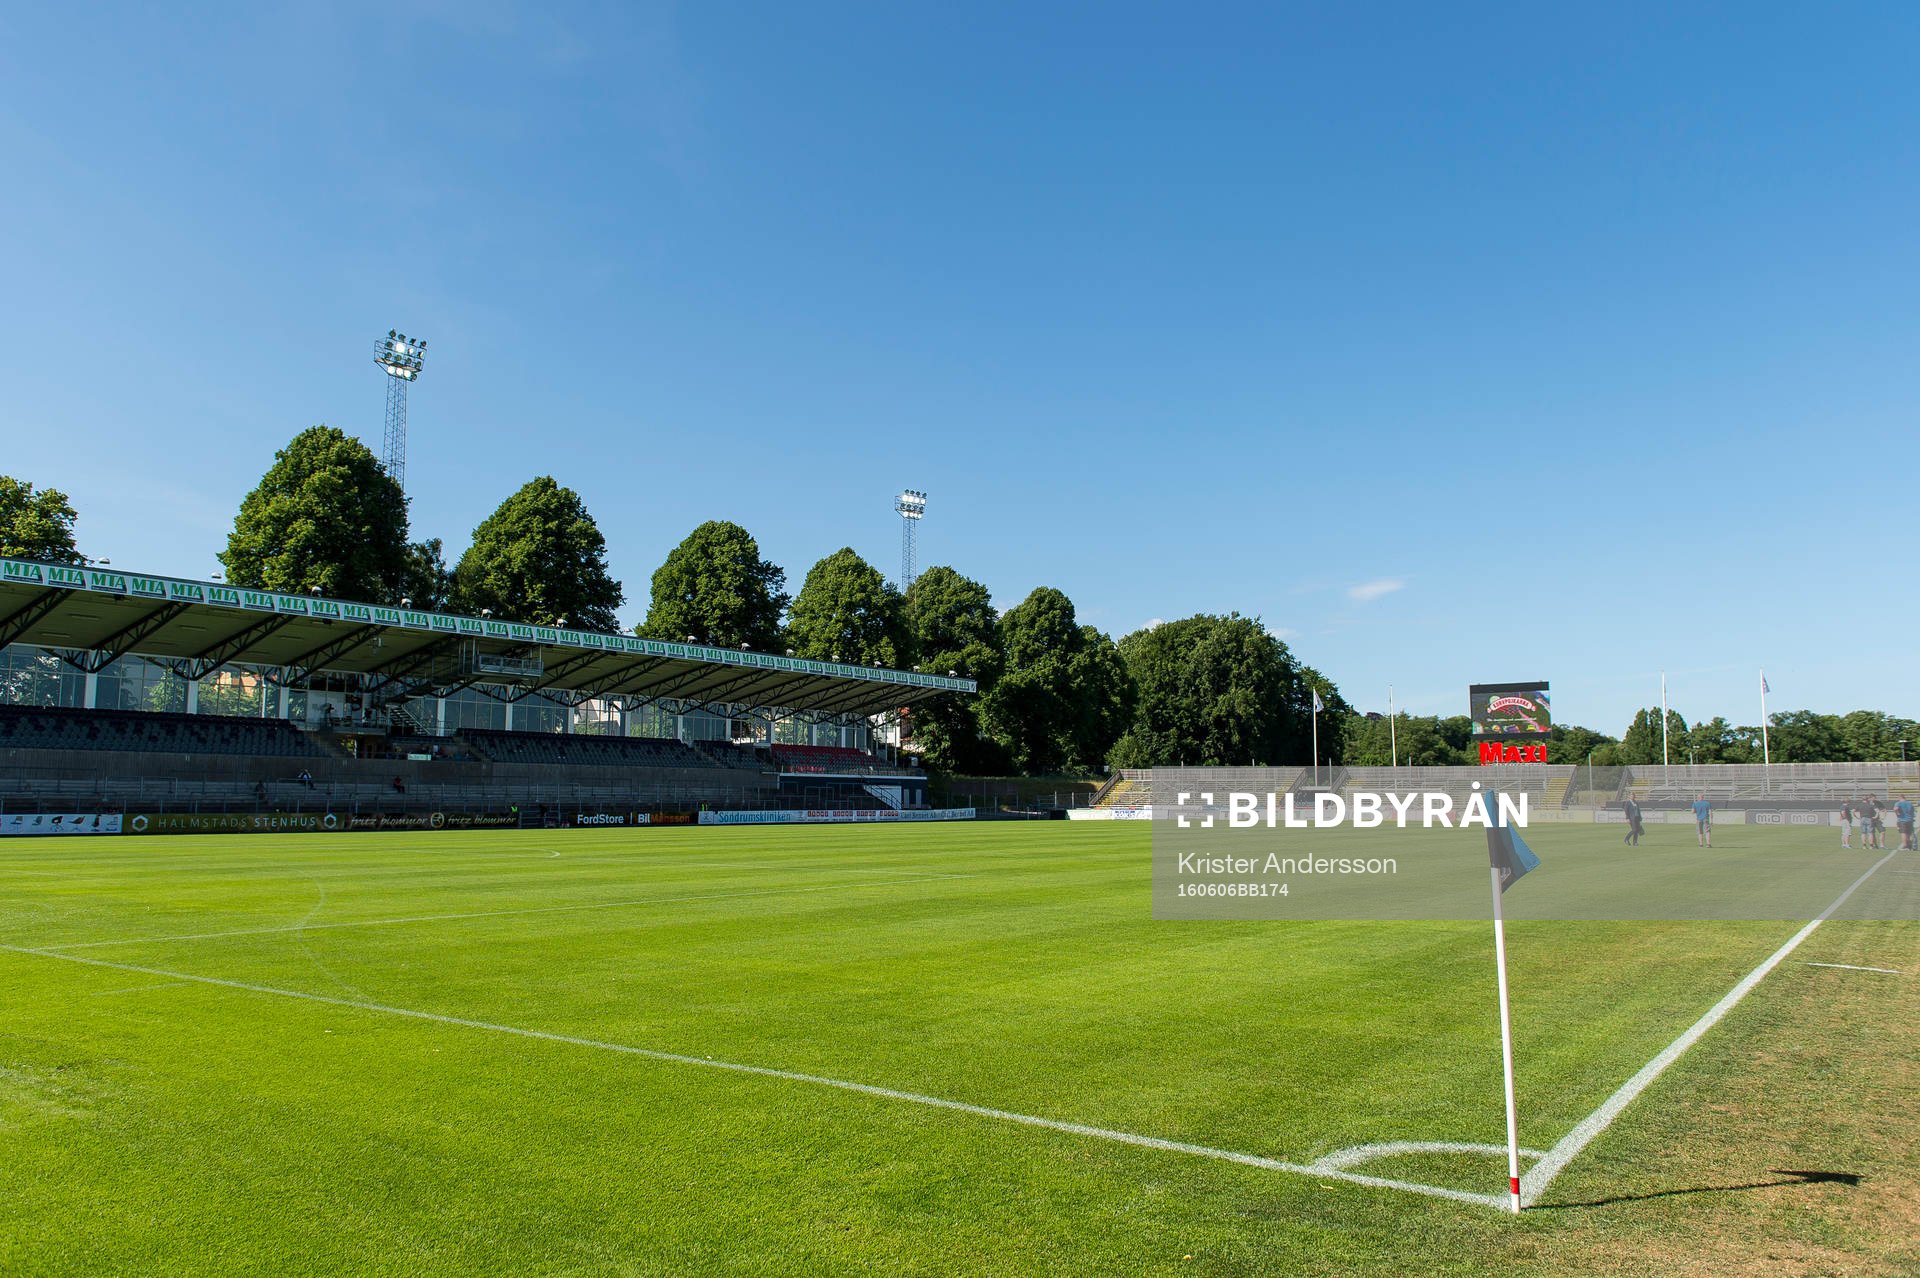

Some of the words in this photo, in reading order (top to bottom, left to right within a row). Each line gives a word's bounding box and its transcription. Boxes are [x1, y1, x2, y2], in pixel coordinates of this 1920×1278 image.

[4, 561, 42, 578] MTA
[49, 567, 85, 583] MTA
[91, 573, 126, 588] MTA
[132, 578, 165, 593] MTA
[171, 583, 203, 598] MTA
[209, 588, 239, 602] MTA
[245, 593, 274, 606] MTA
[279, 597, 307, 610] MTA
[312, 601, 340, 614] MTA
[344, 605, 370, 617] MTA
[375, 609, 400, 621] MTA
[404, 612, 428, 624] MTA
[433, 616, 456, 627] MTA
[460, 619, 483, 630] MTA
[486, 622, 508, 633] MTA
[512, 625, 533, 636] MTA
[536, 628, 557, 639] MTA
[560, 631, 580, 642] MTA
[583, 634, 602, 645] MTA
[606, 637, 624, 647] MTA
[627, 640, 645, 650] MTA
[648, 642, 665, 652] MTA
[668, 645, 685, 654] MTA
[687, 647, 704, 657] MTA
[706, 650, 722, 659] MTA
[725, 652, 740, 661] MTA
[742, 654, 758, 663] MTA
[760, 656, 774, 665] MTA
[776, 658, 791, 667] MTA
[793, 660, 807, 669] MTA
[809, 662, 823, 671] MTA
[825, 664, 838, 672] MTA
[1479, 742, 1547, 763] MAXI
[158, 818, 247, 828] HALMSTADS
[255, 816, 316, 827] STENHUS
[578, 814, 624, 824] FordStore
[720, 812, 791, 822] Söndrumskliniken
